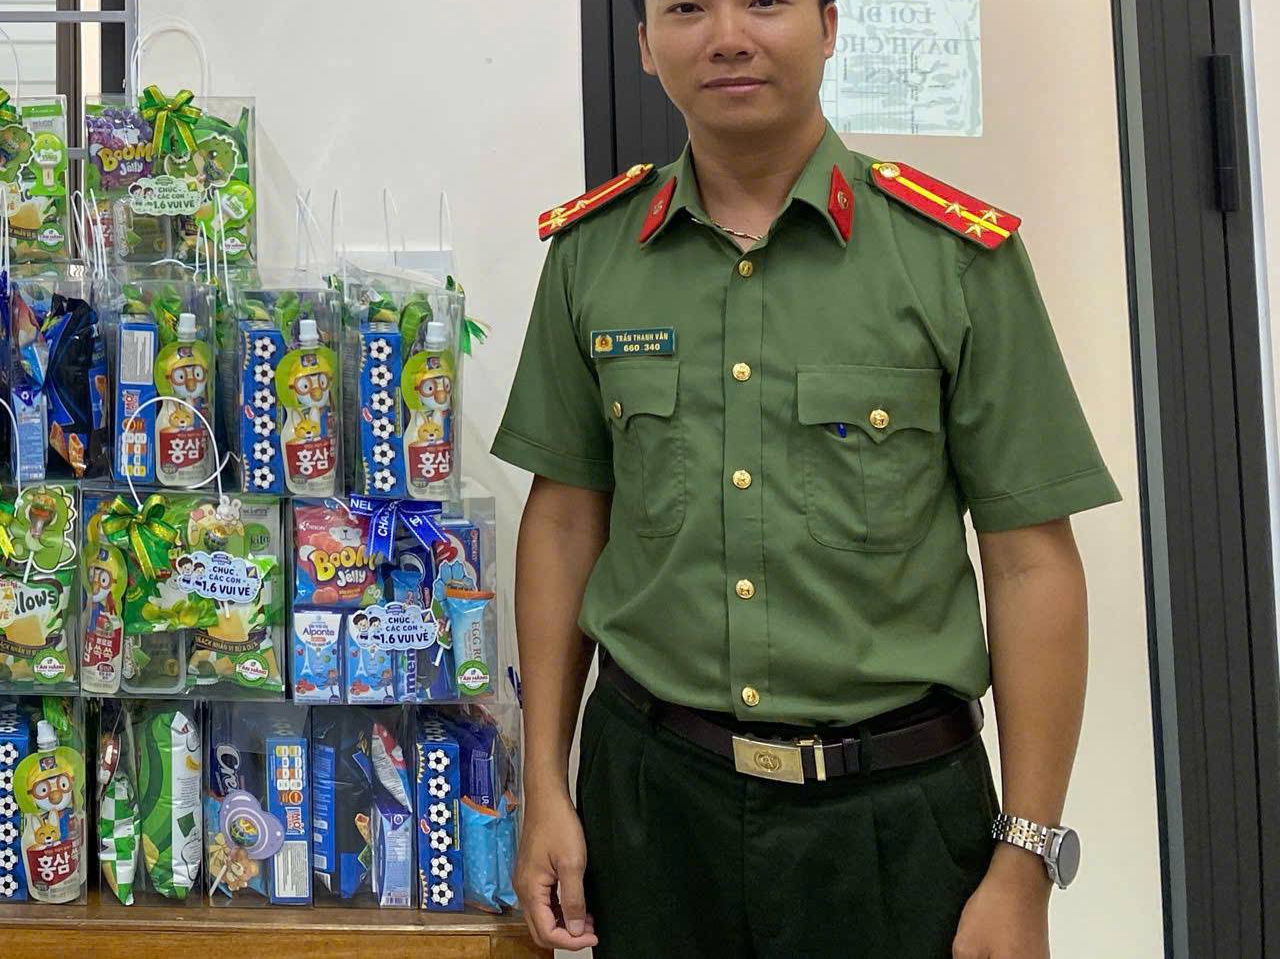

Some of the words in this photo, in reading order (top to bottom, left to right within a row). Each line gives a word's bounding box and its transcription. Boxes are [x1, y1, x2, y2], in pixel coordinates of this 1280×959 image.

[168, 437, 200, 464] 홍삼
[296, 446, 329, 476] 홍삼
[417, 449, 450, 478] 홍삼
[212, 565, 235, 575] CHÚC
[208, 573, 224, 583] CÁC
[225, 576, 242, 584] CON
[202, 580, 217, 593] 1.6
[219, 584, 237, 596] VUI
[388, 615, 411, 624] CHÚC
[385, 624, 403, 632] CÁC
[380, 633, 395, 644] 1.6
[397, 633, 415, 643] VUI
[37, 850, 70, 882] 홍삼
